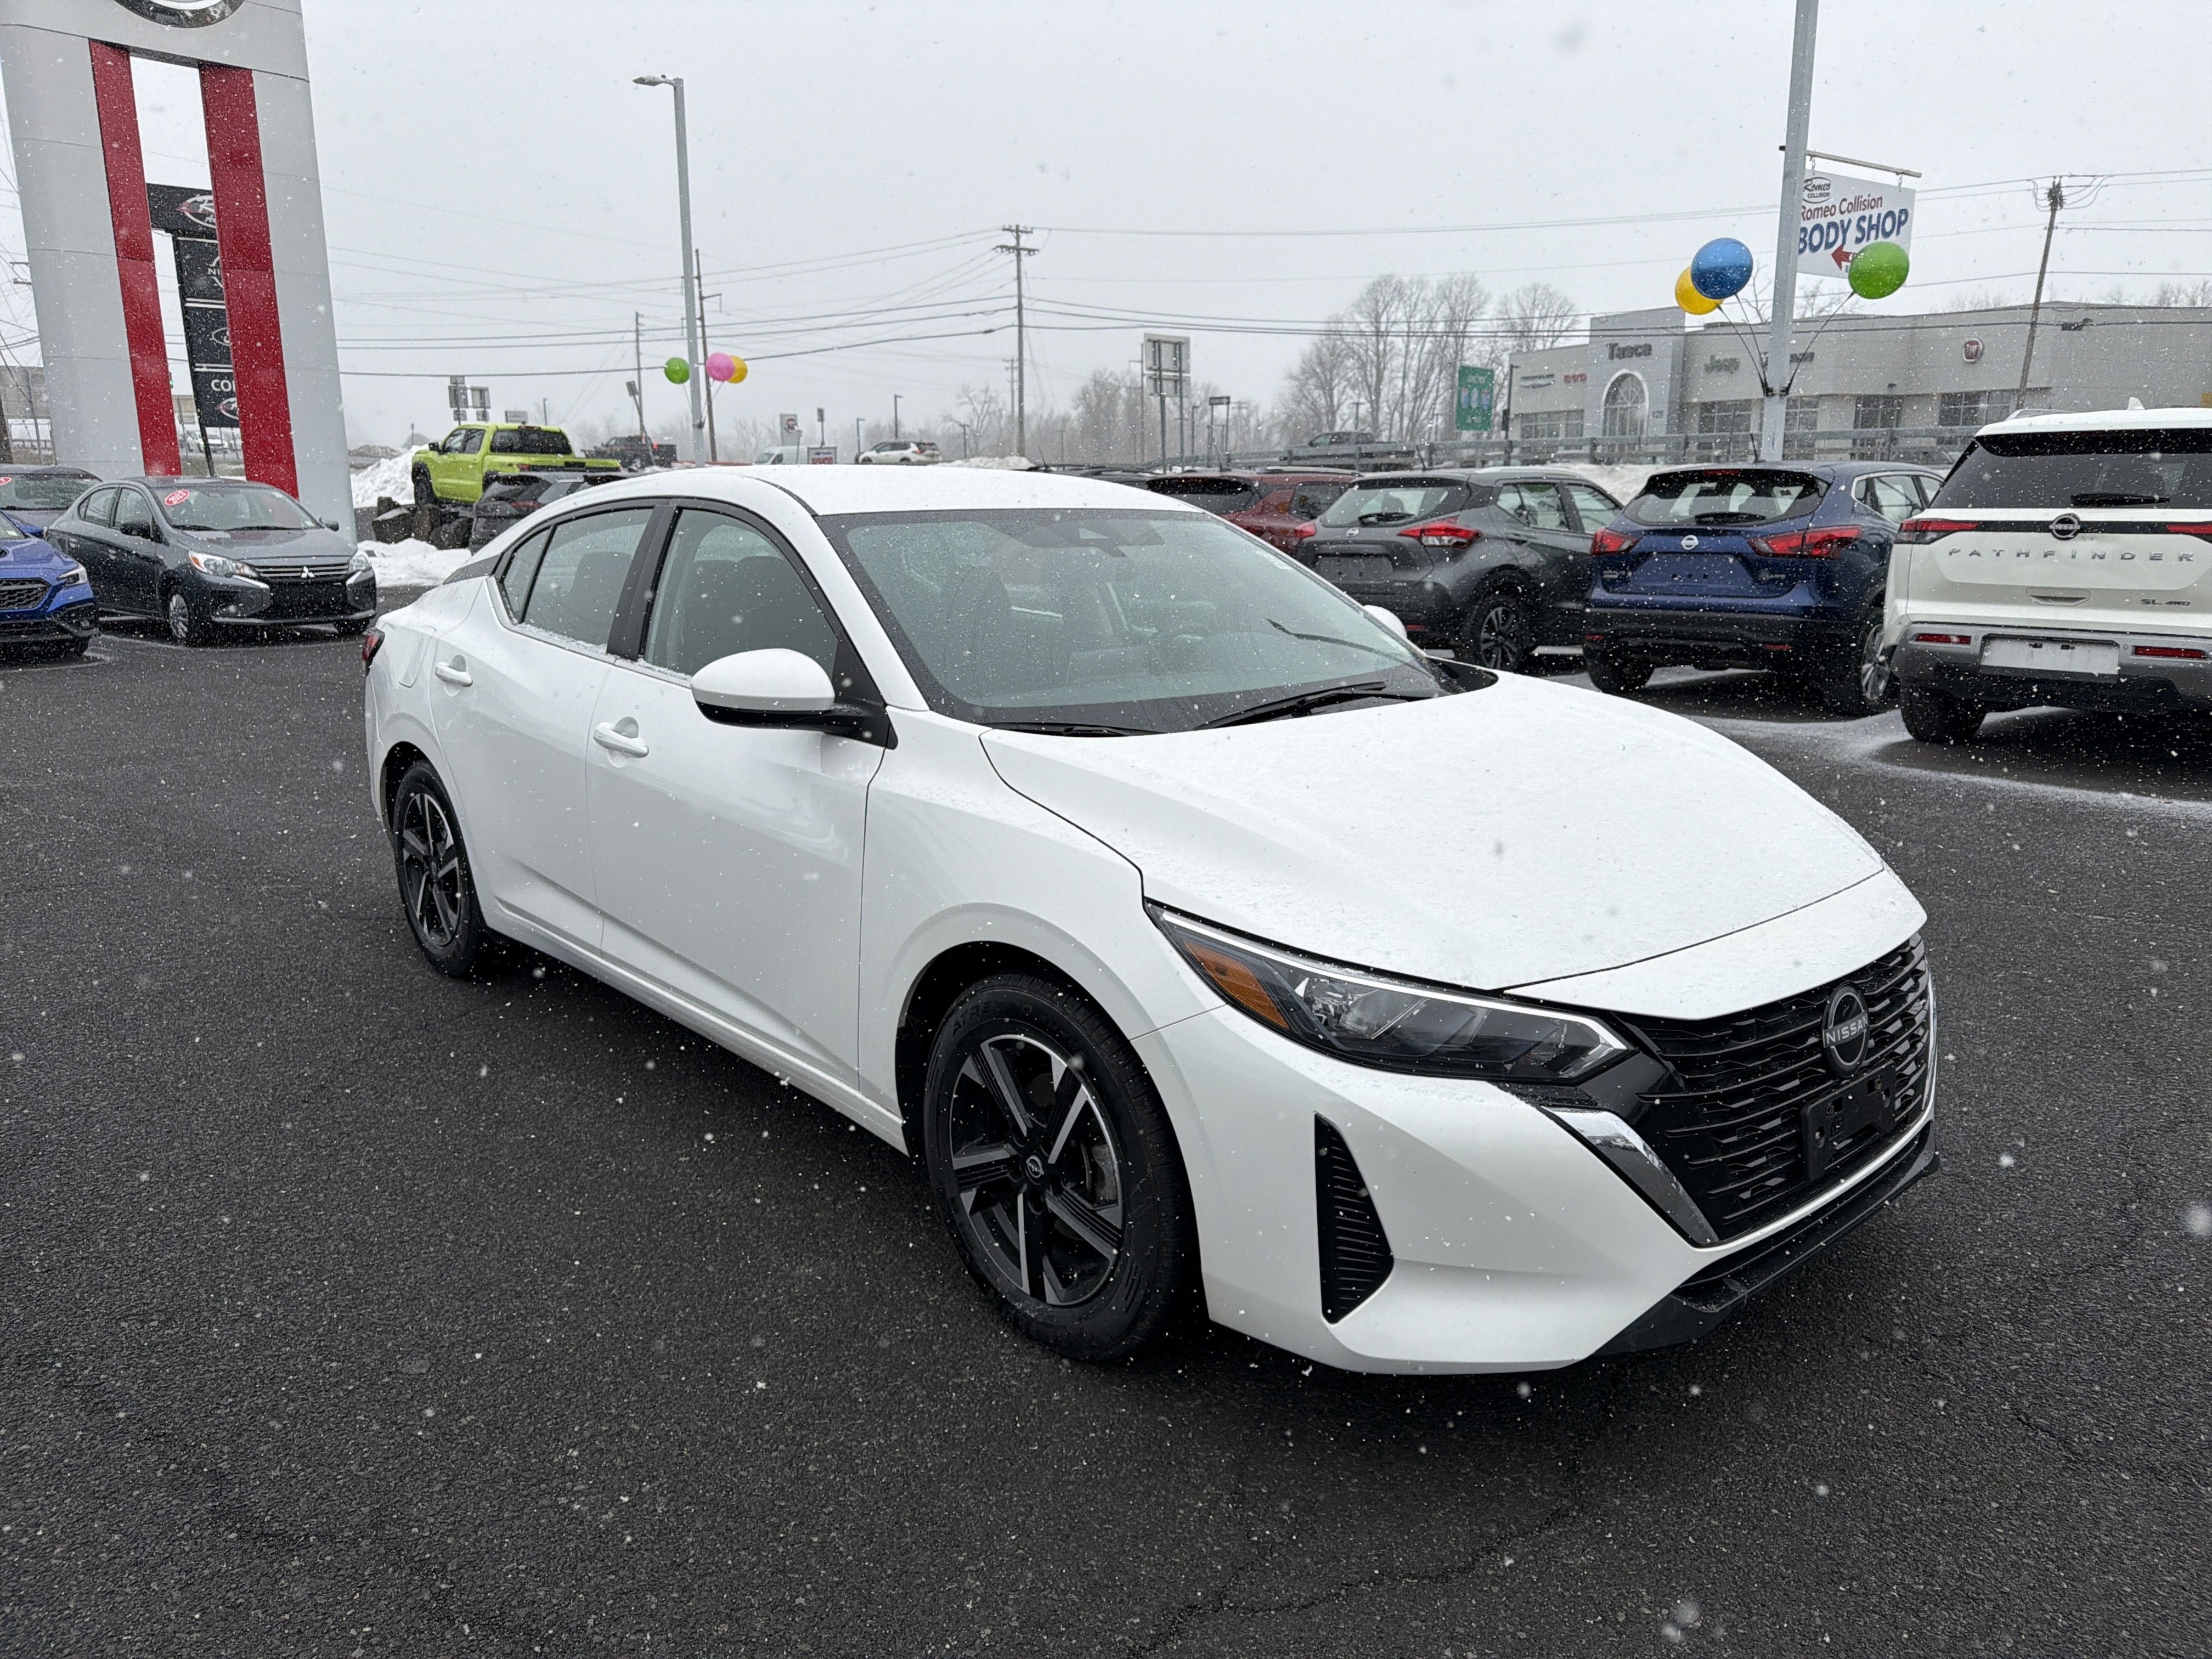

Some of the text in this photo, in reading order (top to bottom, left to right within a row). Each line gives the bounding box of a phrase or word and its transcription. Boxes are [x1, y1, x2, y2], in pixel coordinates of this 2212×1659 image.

[1803, 179, 1831, 192] Romeo
[1801, 194, 1883, 221] Romeo Collision
[1798, 208, 1909, 255] BODY SHOP
[1949, 549, 2193, 562] PATHFINDER
[1826, 1014, 1868, 1044] NISSAN
